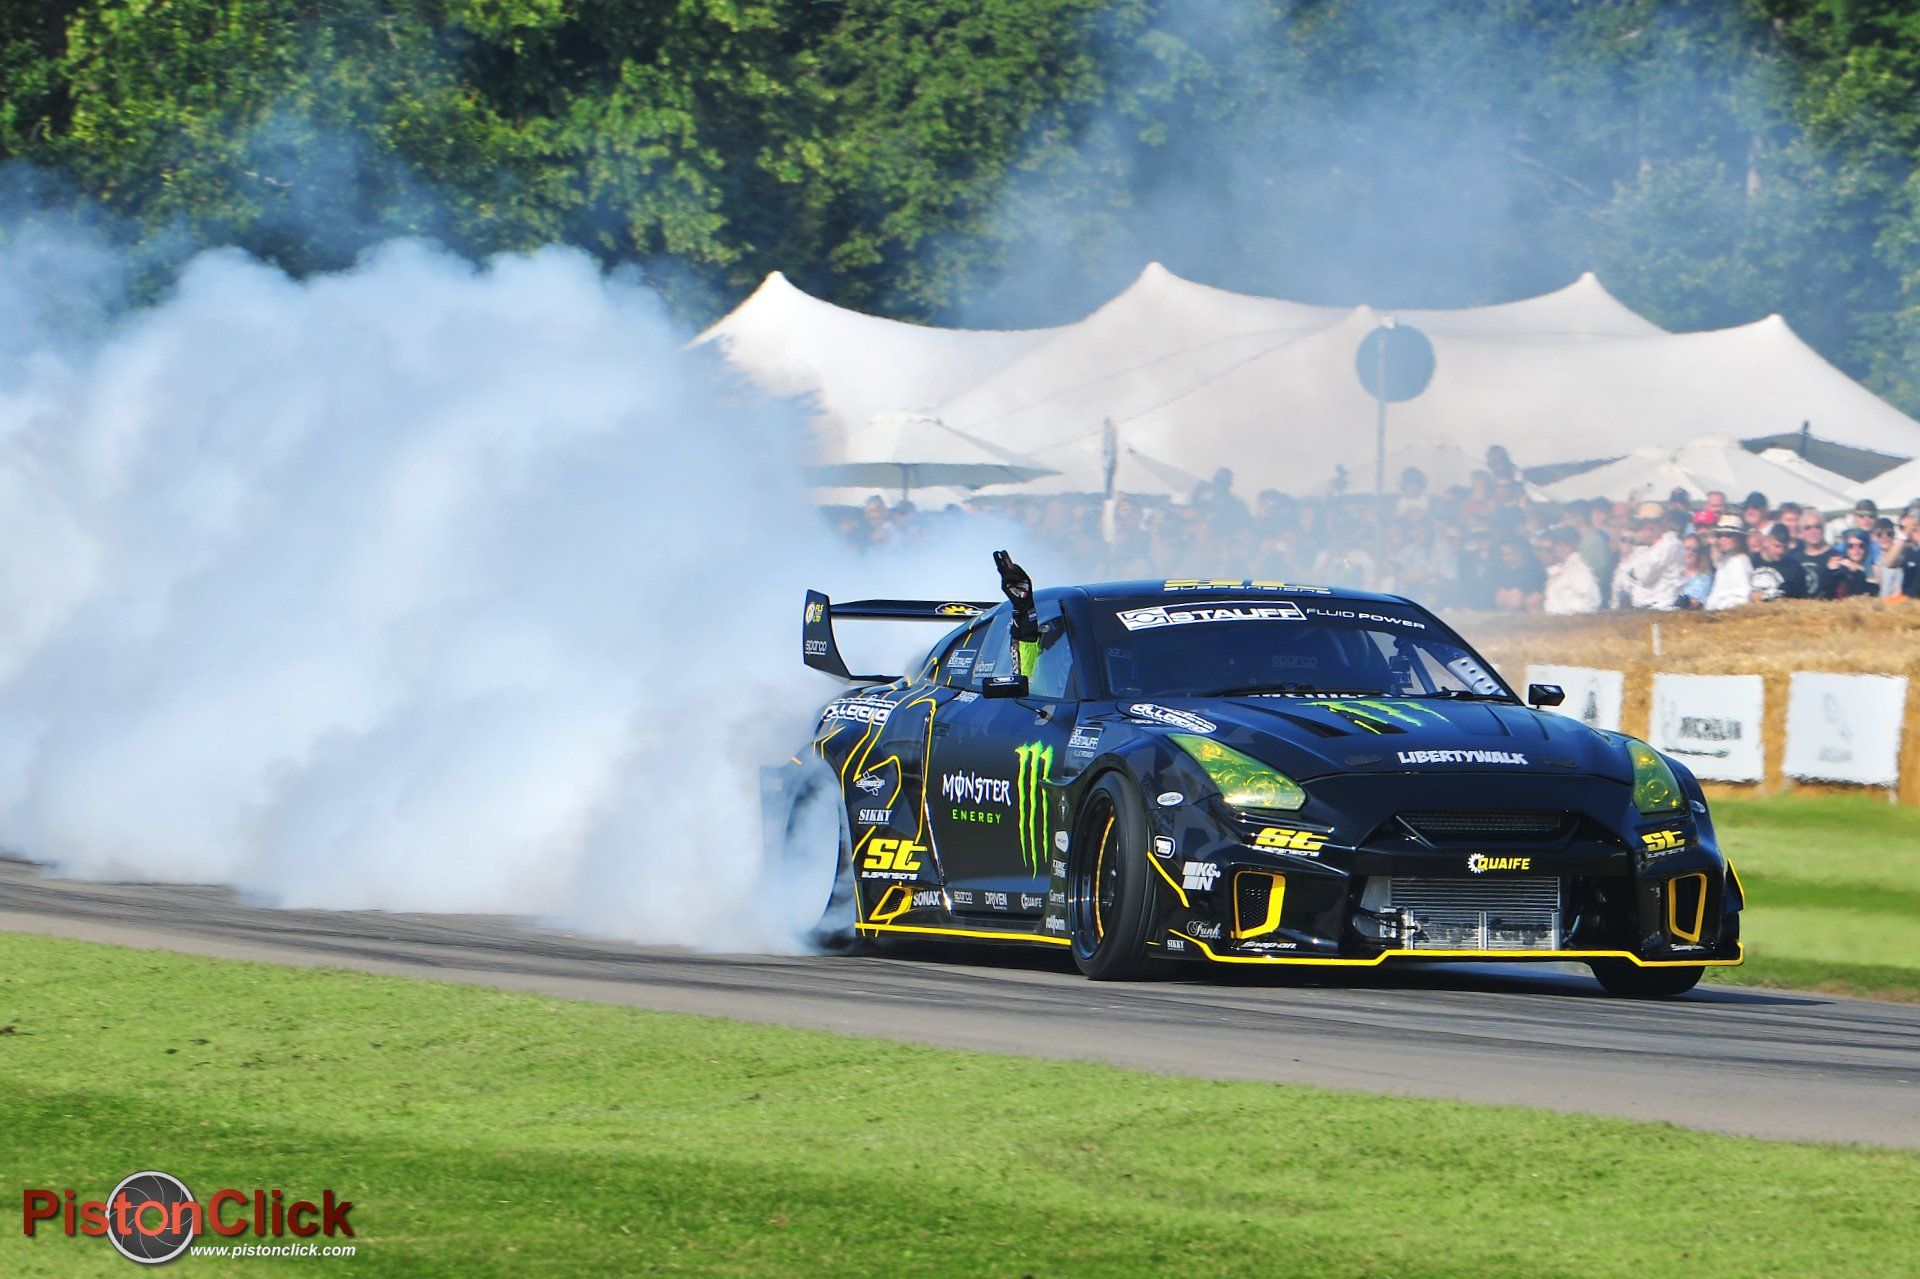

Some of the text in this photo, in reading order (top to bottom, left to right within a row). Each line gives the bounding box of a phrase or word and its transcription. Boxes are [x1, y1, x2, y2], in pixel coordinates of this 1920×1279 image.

[1169, 608, 1425, 629] STAUFF FLUID POWER
[805, 640, 827, 652] sparco
[1272, 655, 1318, 667] sparco
[1397, 750, 1528, 765] LIBERTYWALK
[942, 770, 1012, 807] MONSTER
[858, 809, 892, 822] SIKKY
[952, 809, 1001, 824] ENERGY
[1255, 827, 1330, 851] st
[1641, 830, 1686, 852] st
[863, 838, 928, 871] st
[1477, 857, 1531, 871] QUAIFE
[913, 891, 941, 906] SONAX
[954, 891, 973, 901] sparco
[984, 892, 1008, 907] DRIVEN
[1187, 920, 1221, 938] Funk
[1167, 940, 1184, 949] SIKKY
[1241, 941, 1297, 949] Snap-on
